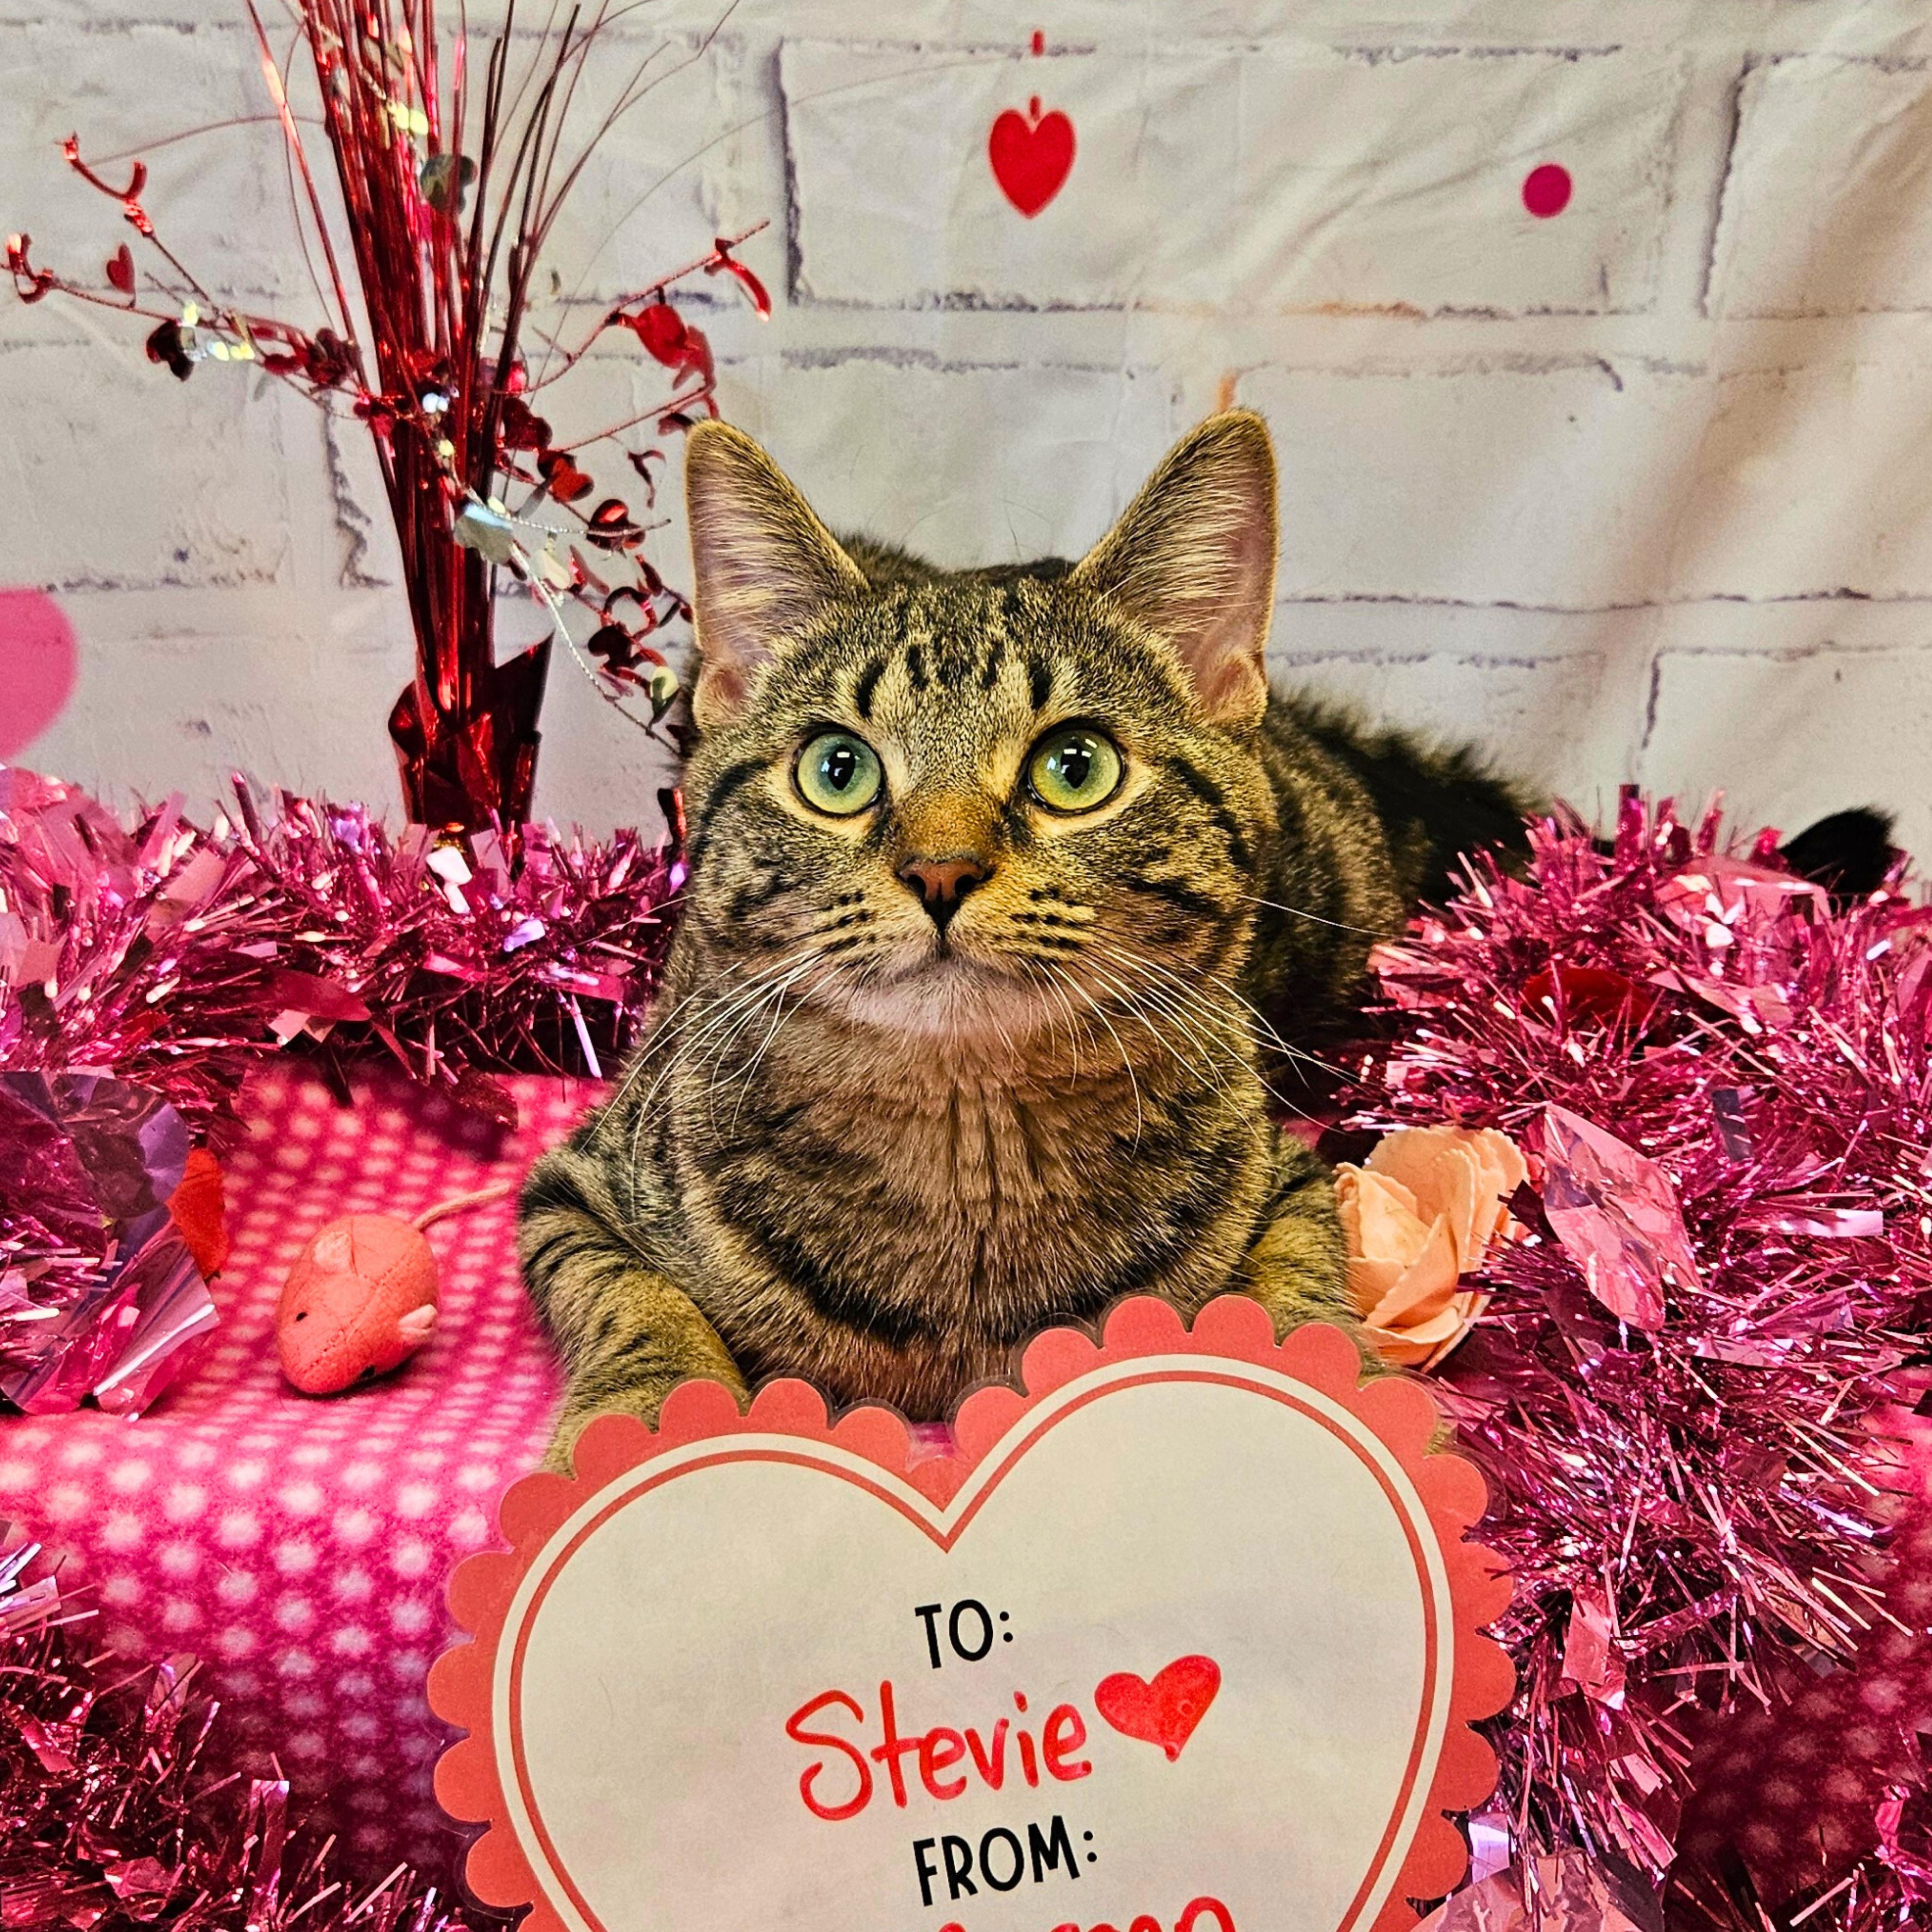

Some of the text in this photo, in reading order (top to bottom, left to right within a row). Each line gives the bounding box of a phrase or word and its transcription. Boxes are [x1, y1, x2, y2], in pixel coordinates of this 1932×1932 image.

[914, 1599, 1013, 1669] TO:
[785, 1679, 1093, 1822] Stevie
[913, 1815, 1097, 1906] FROM:
